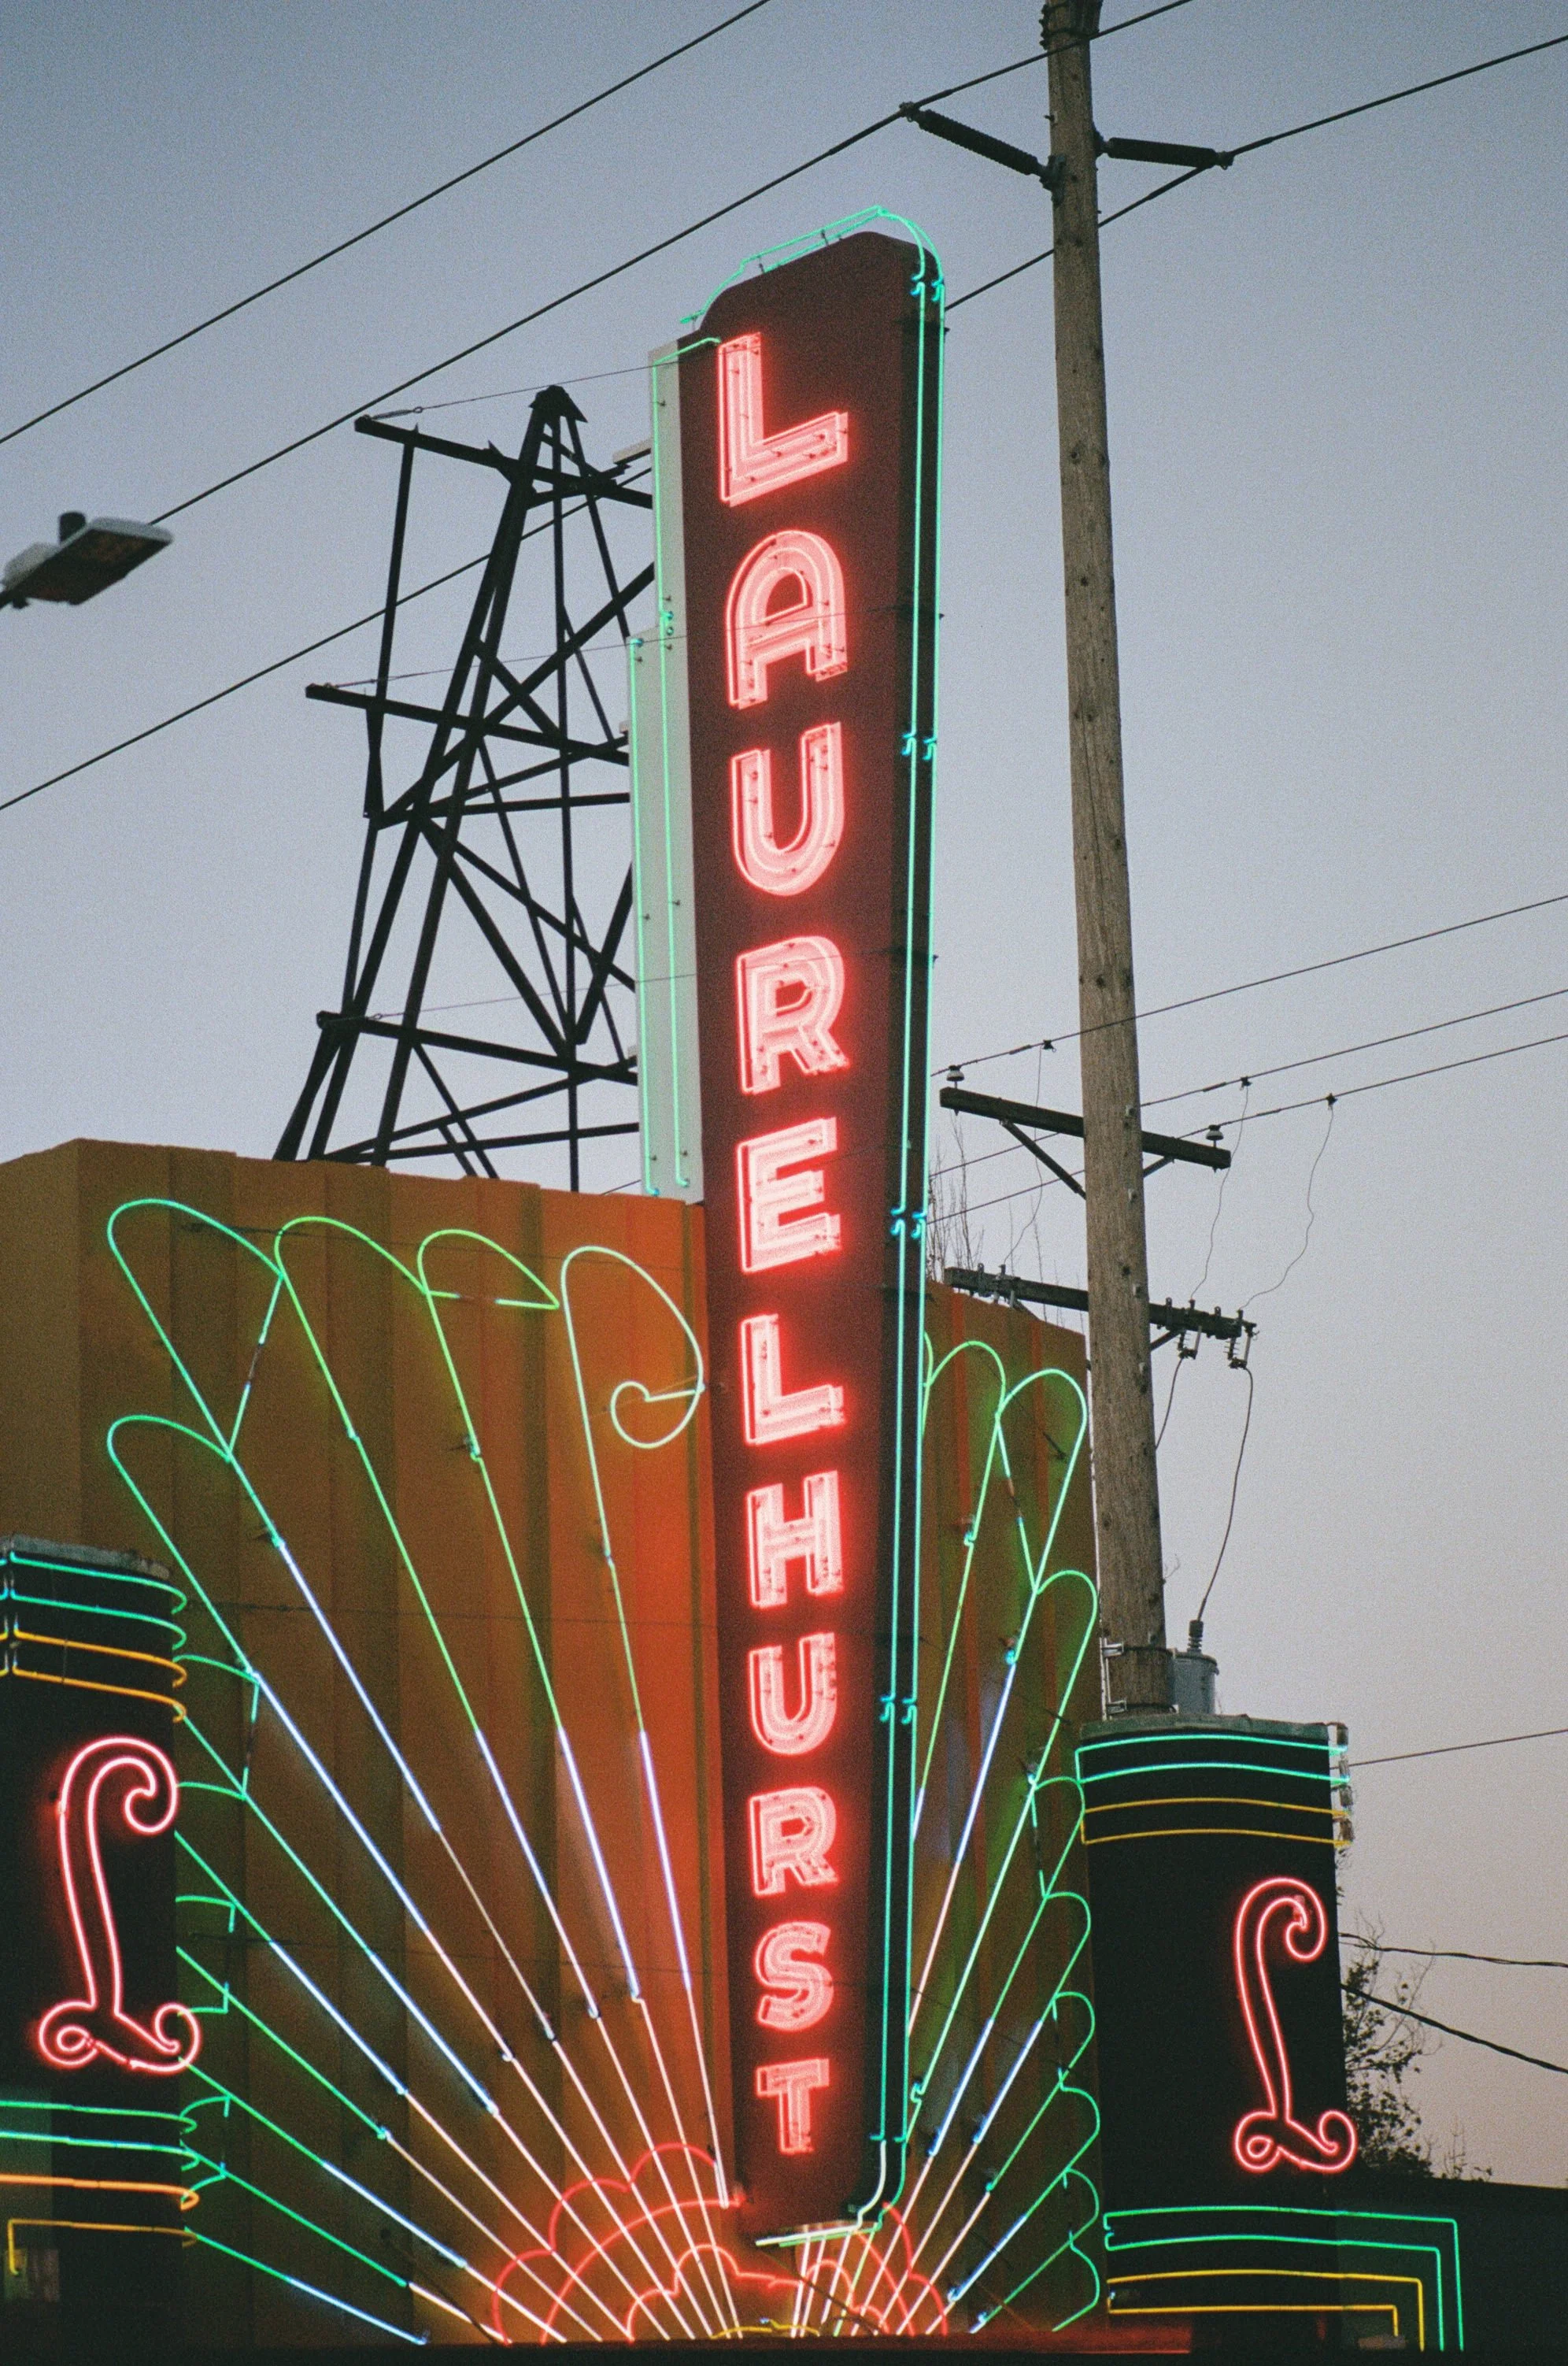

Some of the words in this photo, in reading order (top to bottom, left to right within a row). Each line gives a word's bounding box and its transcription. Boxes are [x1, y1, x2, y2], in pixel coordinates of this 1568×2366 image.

[717, 331, 850, 2155] LAURELHURST
[38, 1737, 202, 2075] L
[1233, 1877, 1357, 2173] L
